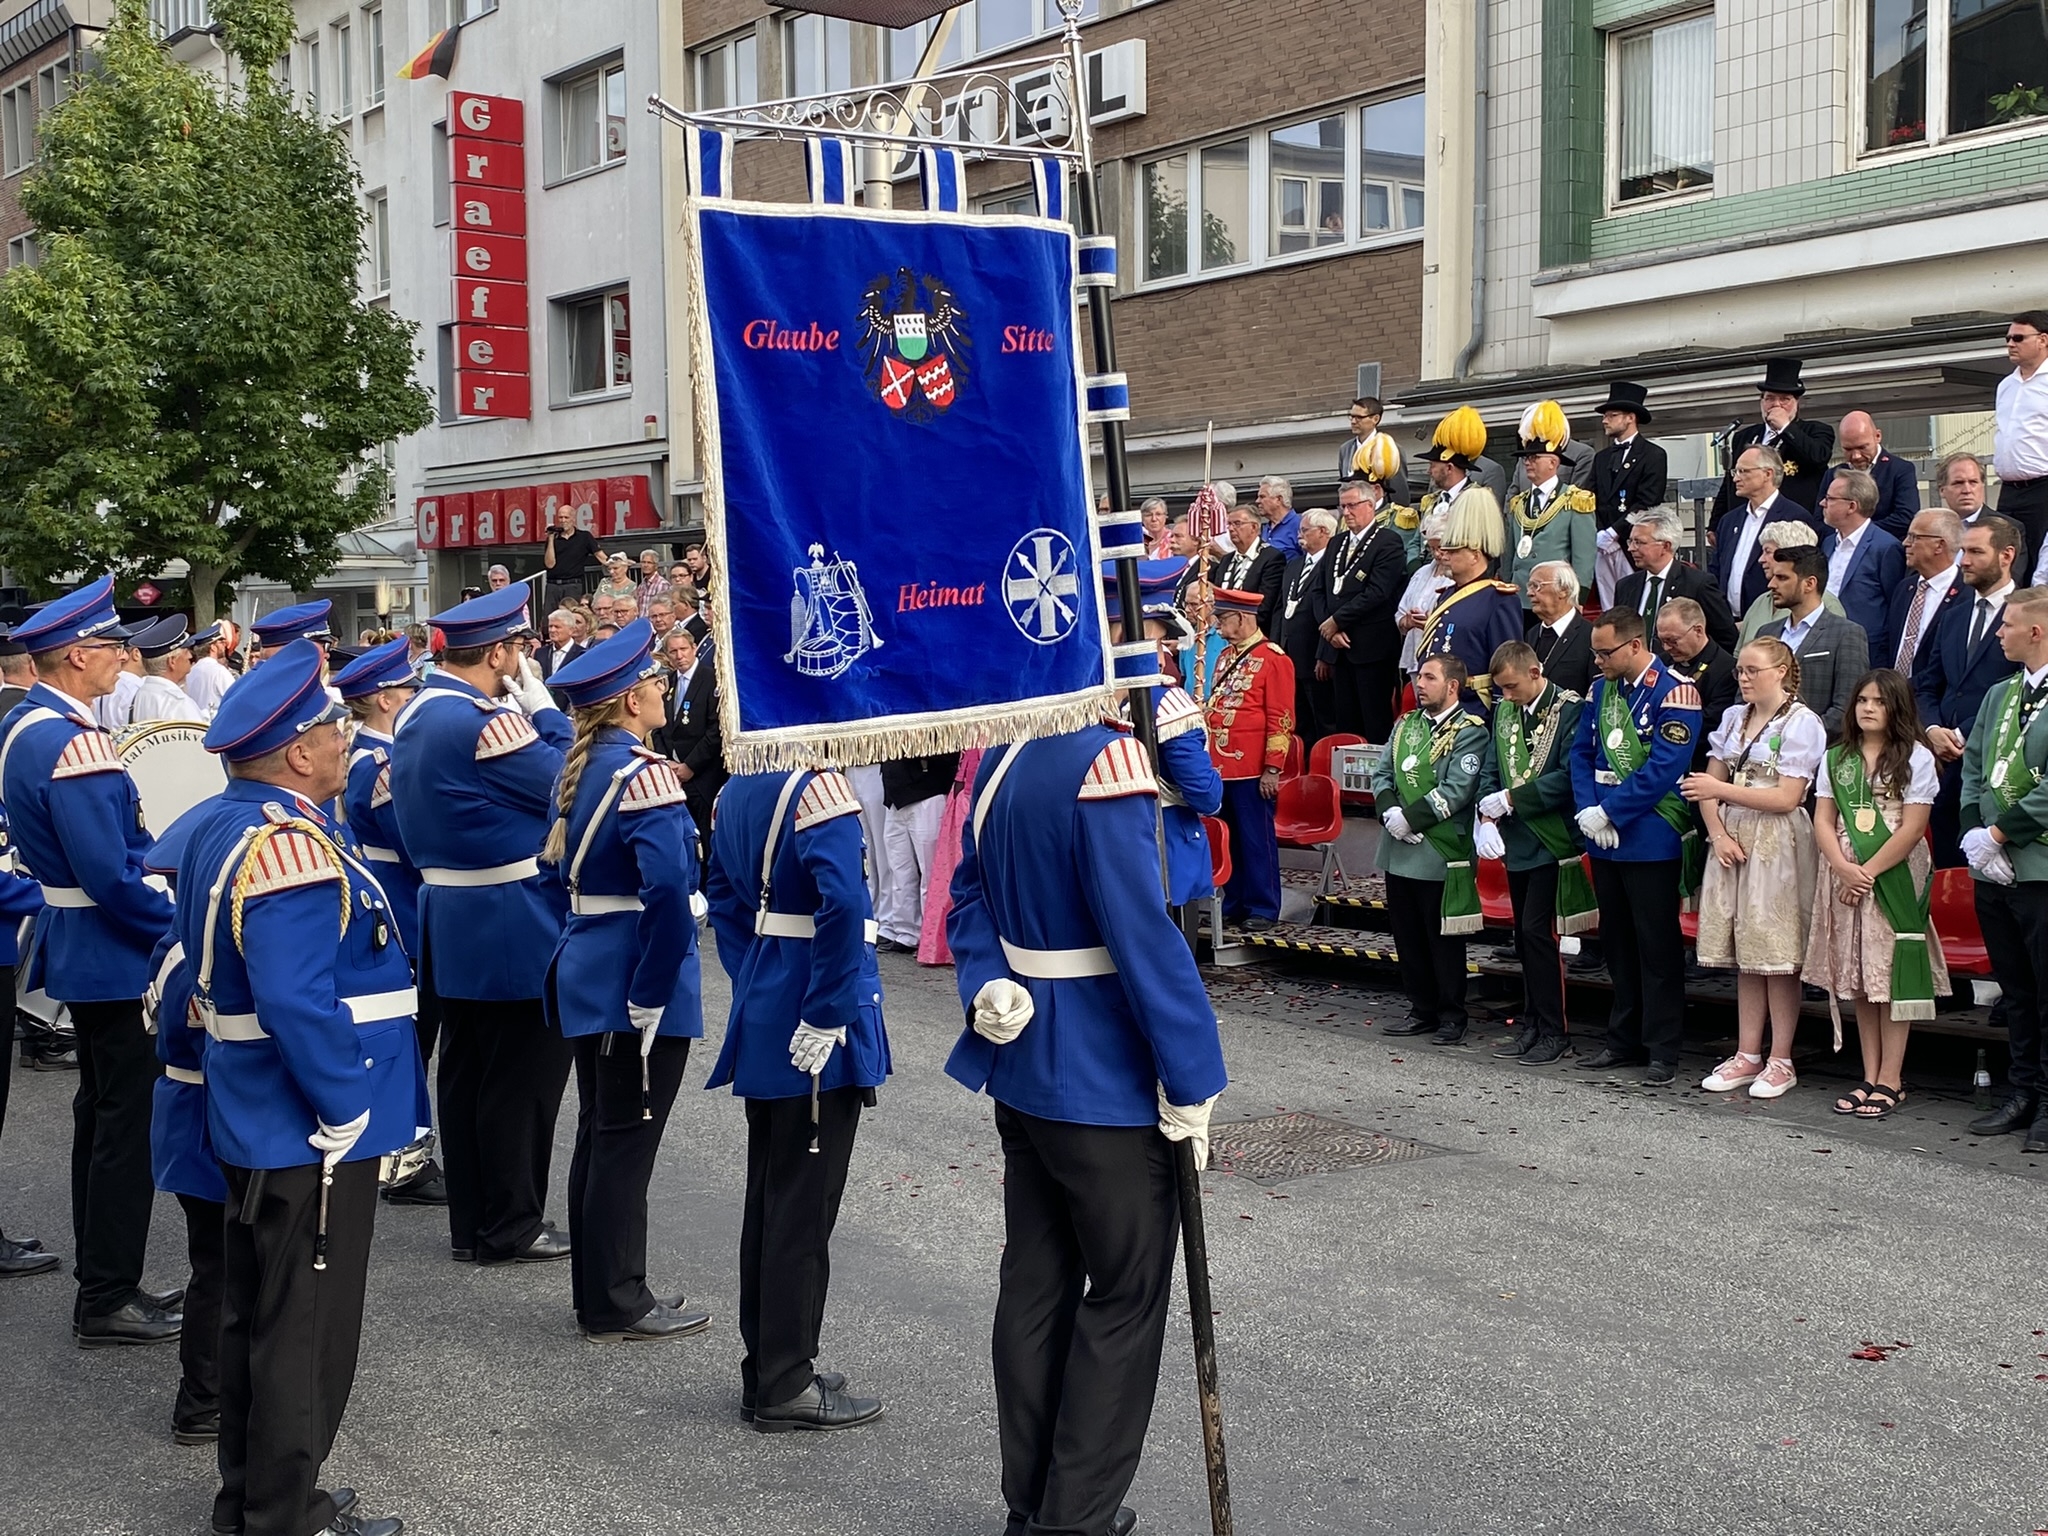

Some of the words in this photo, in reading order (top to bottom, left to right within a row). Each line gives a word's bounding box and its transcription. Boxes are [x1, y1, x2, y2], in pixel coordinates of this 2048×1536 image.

[460, 98, 494, 411] Graefer
[743, 319, 840, 351] Glaube
[1001, 325, 1056, 353] Sitte
[418, 495, 630, 544] Graefer
[896, 580, 985, 613] Heimat
[122, 730, 205, 769] tal-Musikv
